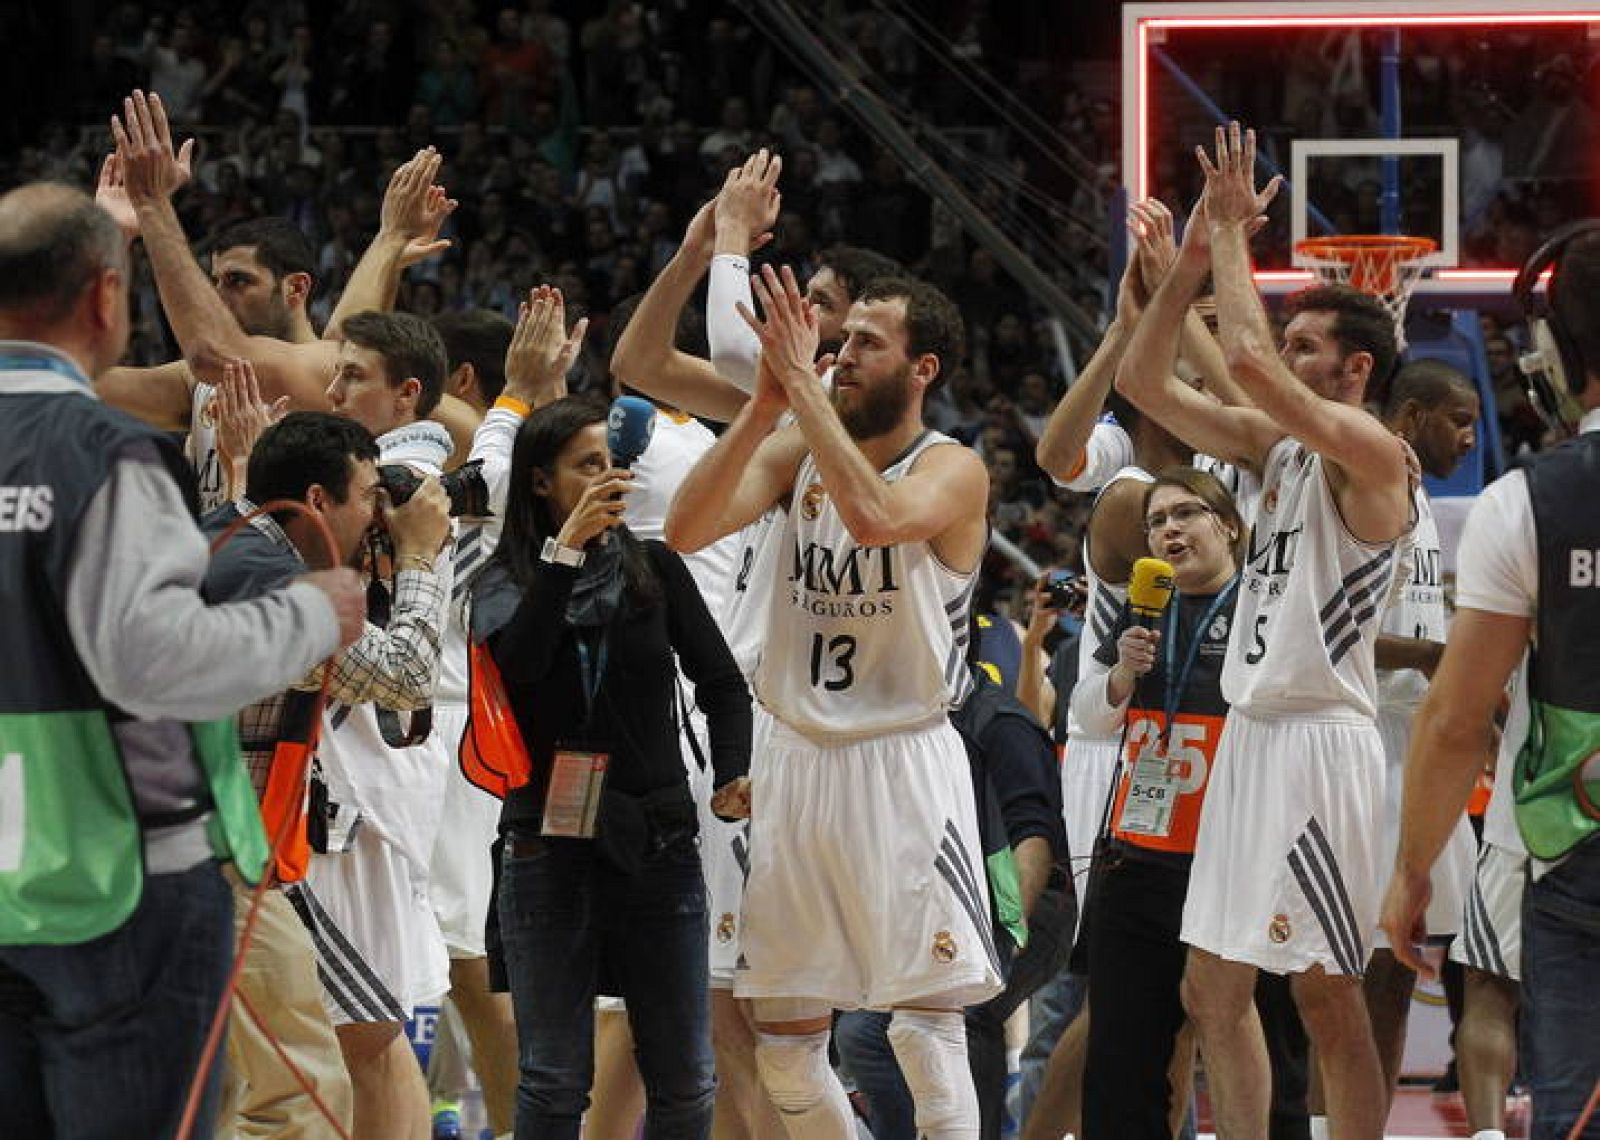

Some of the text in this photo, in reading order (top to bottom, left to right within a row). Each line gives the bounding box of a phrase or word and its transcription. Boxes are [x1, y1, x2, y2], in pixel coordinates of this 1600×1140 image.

[1568, 549, 1600, 589] B
[809, 632, 856, 691] 13
[1245, 615, 1268, 665] 5
